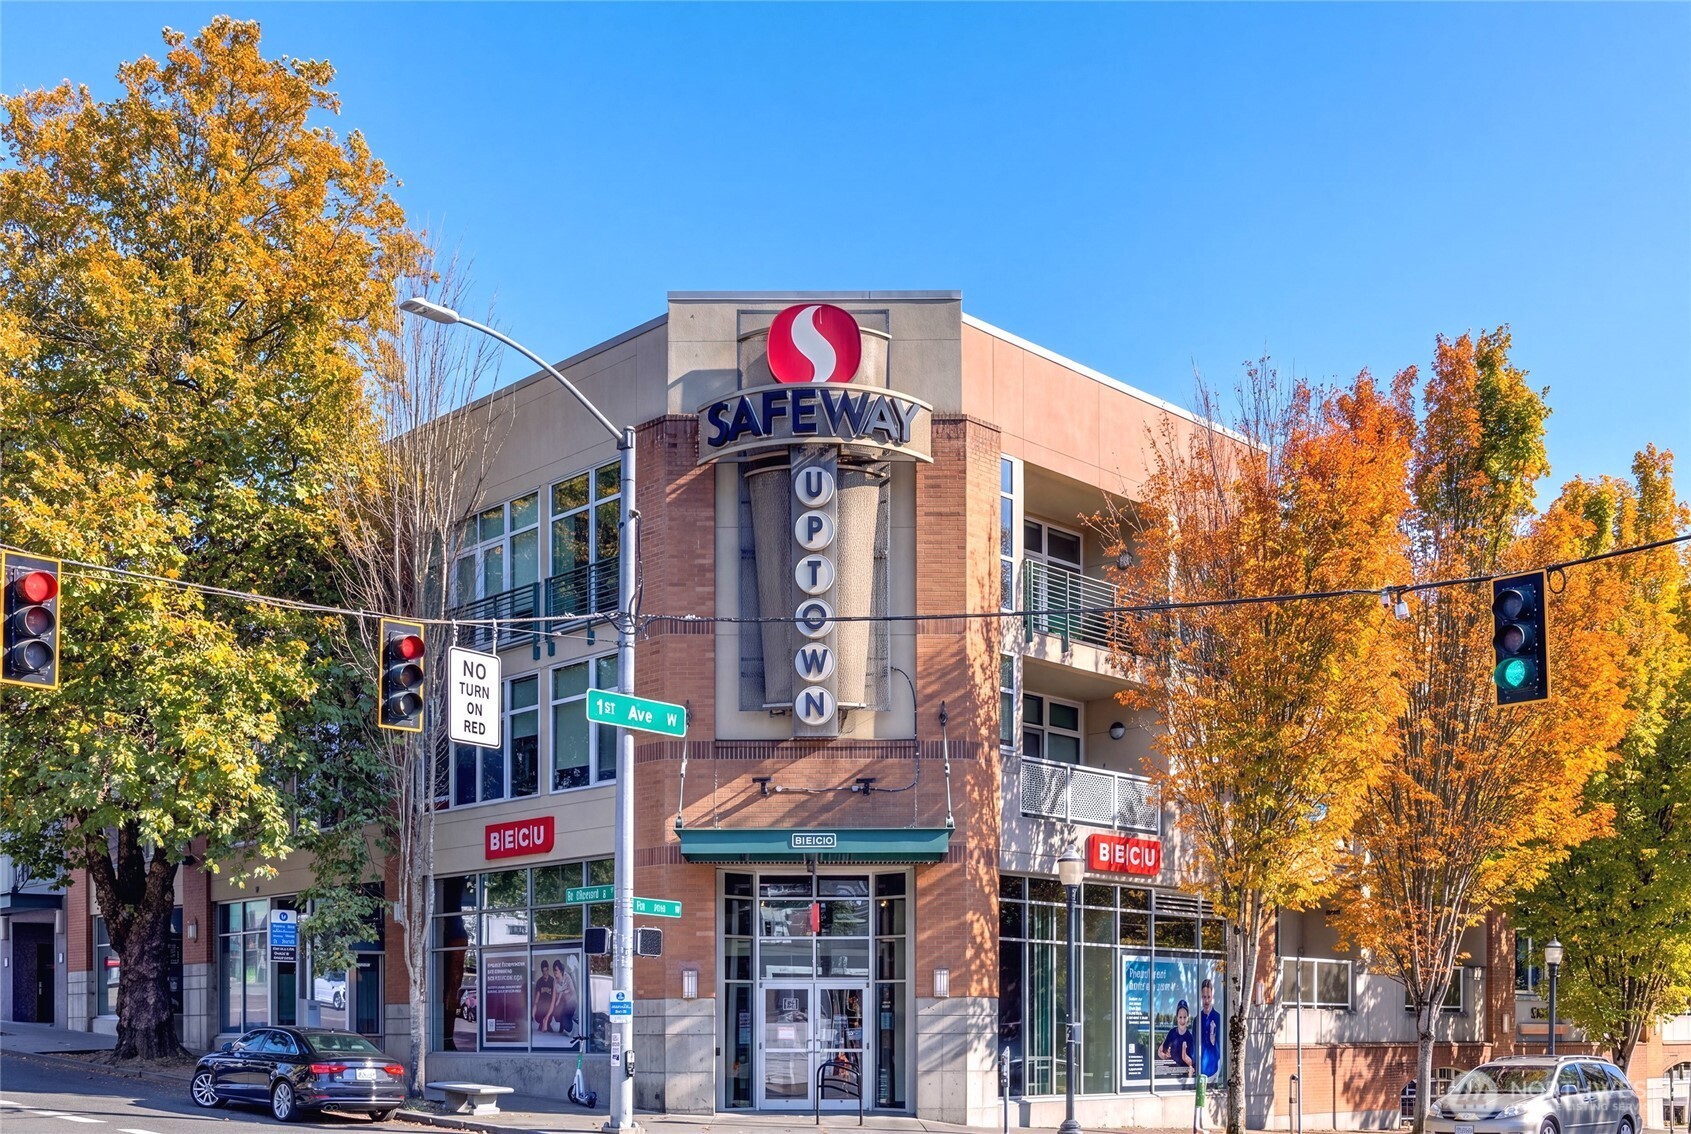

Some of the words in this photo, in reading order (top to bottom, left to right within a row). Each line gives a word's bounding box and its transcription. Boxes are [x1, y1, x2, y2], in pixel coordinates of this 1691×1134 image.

[707, 388, 921, 448] SAFEWAY
[800, 471, 828, 718] UPTOWN
[463, 660, 487, 680] NO
[459, 681, 490, 700] TURN
[467, 702, 483, 717] ON
[596, 699, 616, 715] 1ST
[627, 705, 653, 723] Ave
[666, 712, 678, 727] W
[464, 720, 486, 736] RED
